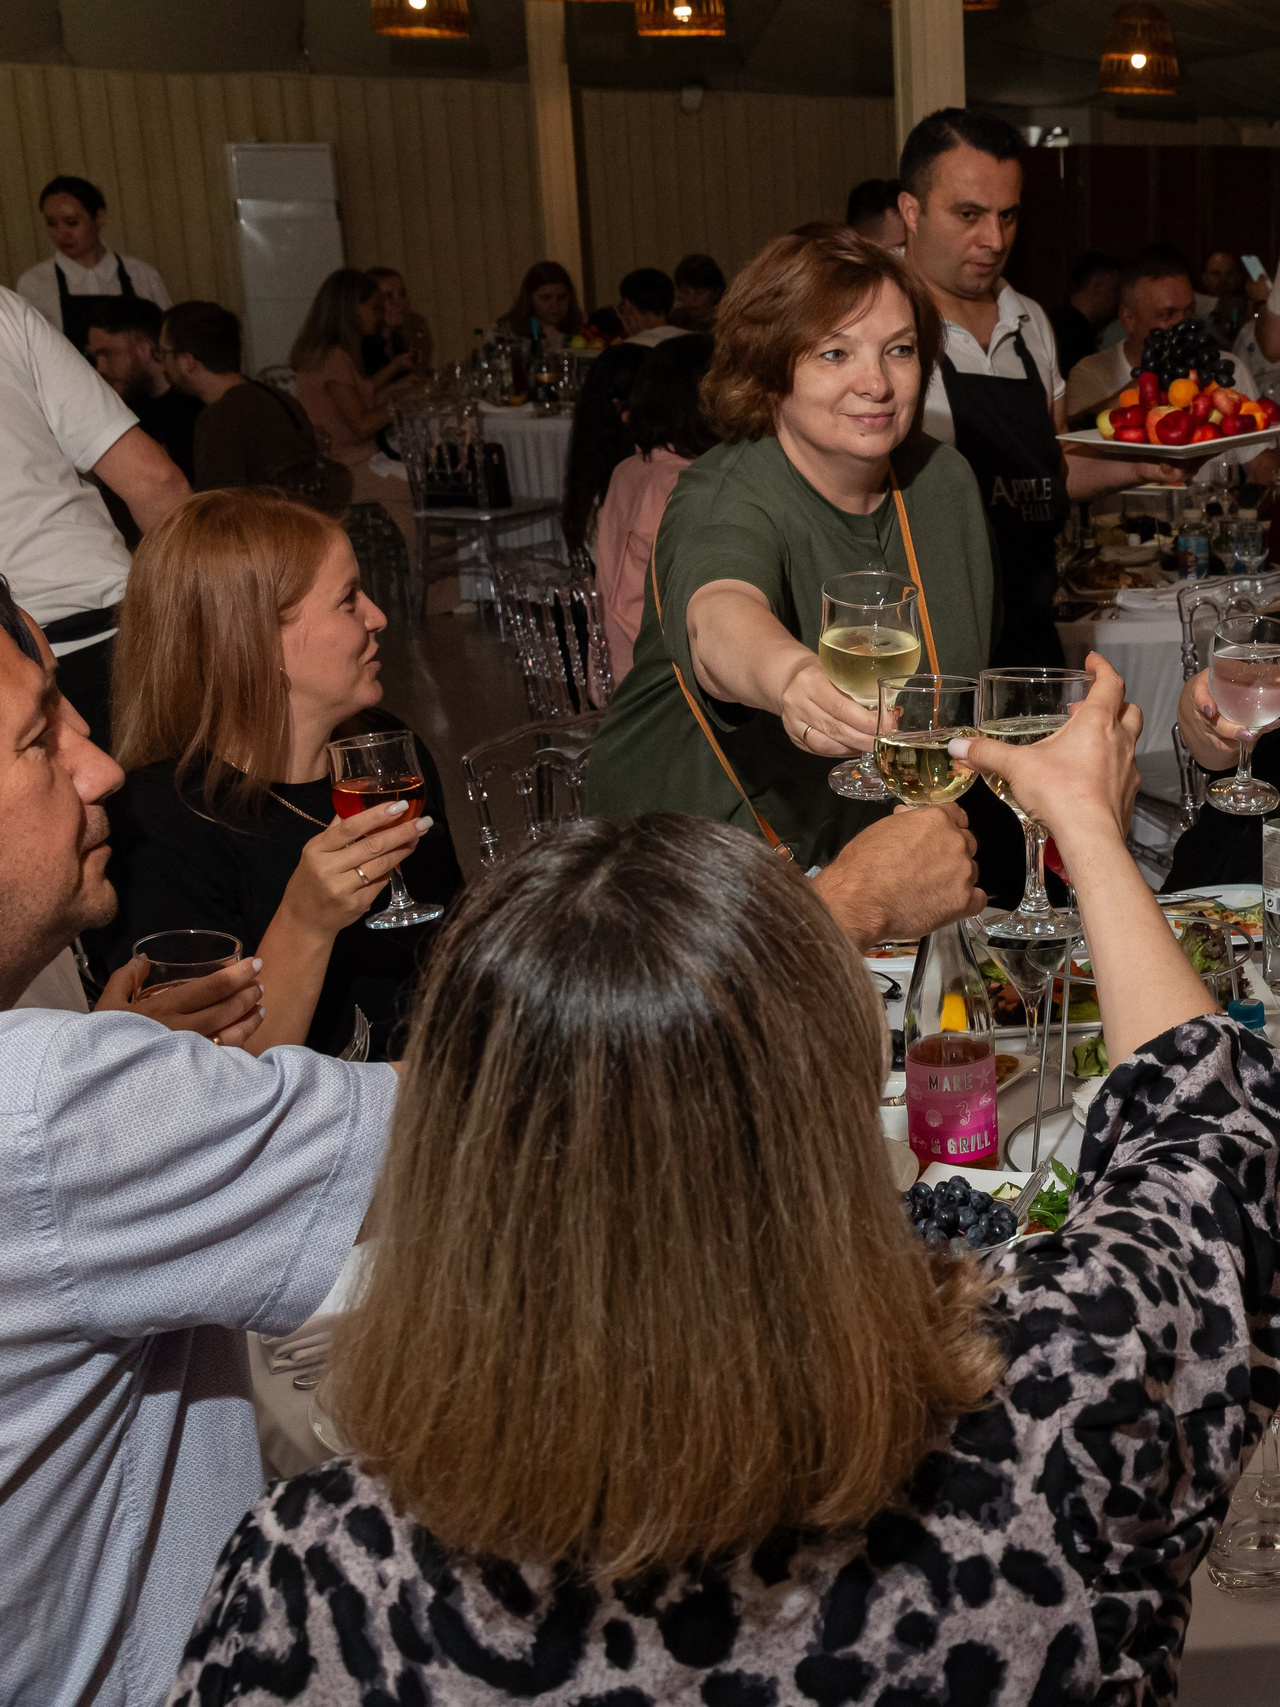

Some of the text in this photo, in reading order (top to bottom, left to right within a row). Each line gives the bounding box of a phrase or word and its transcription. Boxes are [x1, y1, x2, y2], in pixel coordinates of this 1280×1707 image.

[990, 476, 1052, 508] APPLE
[928, 1074, 973, 1092] MARE
[931, 1131, 991, 1155] & GRILL
